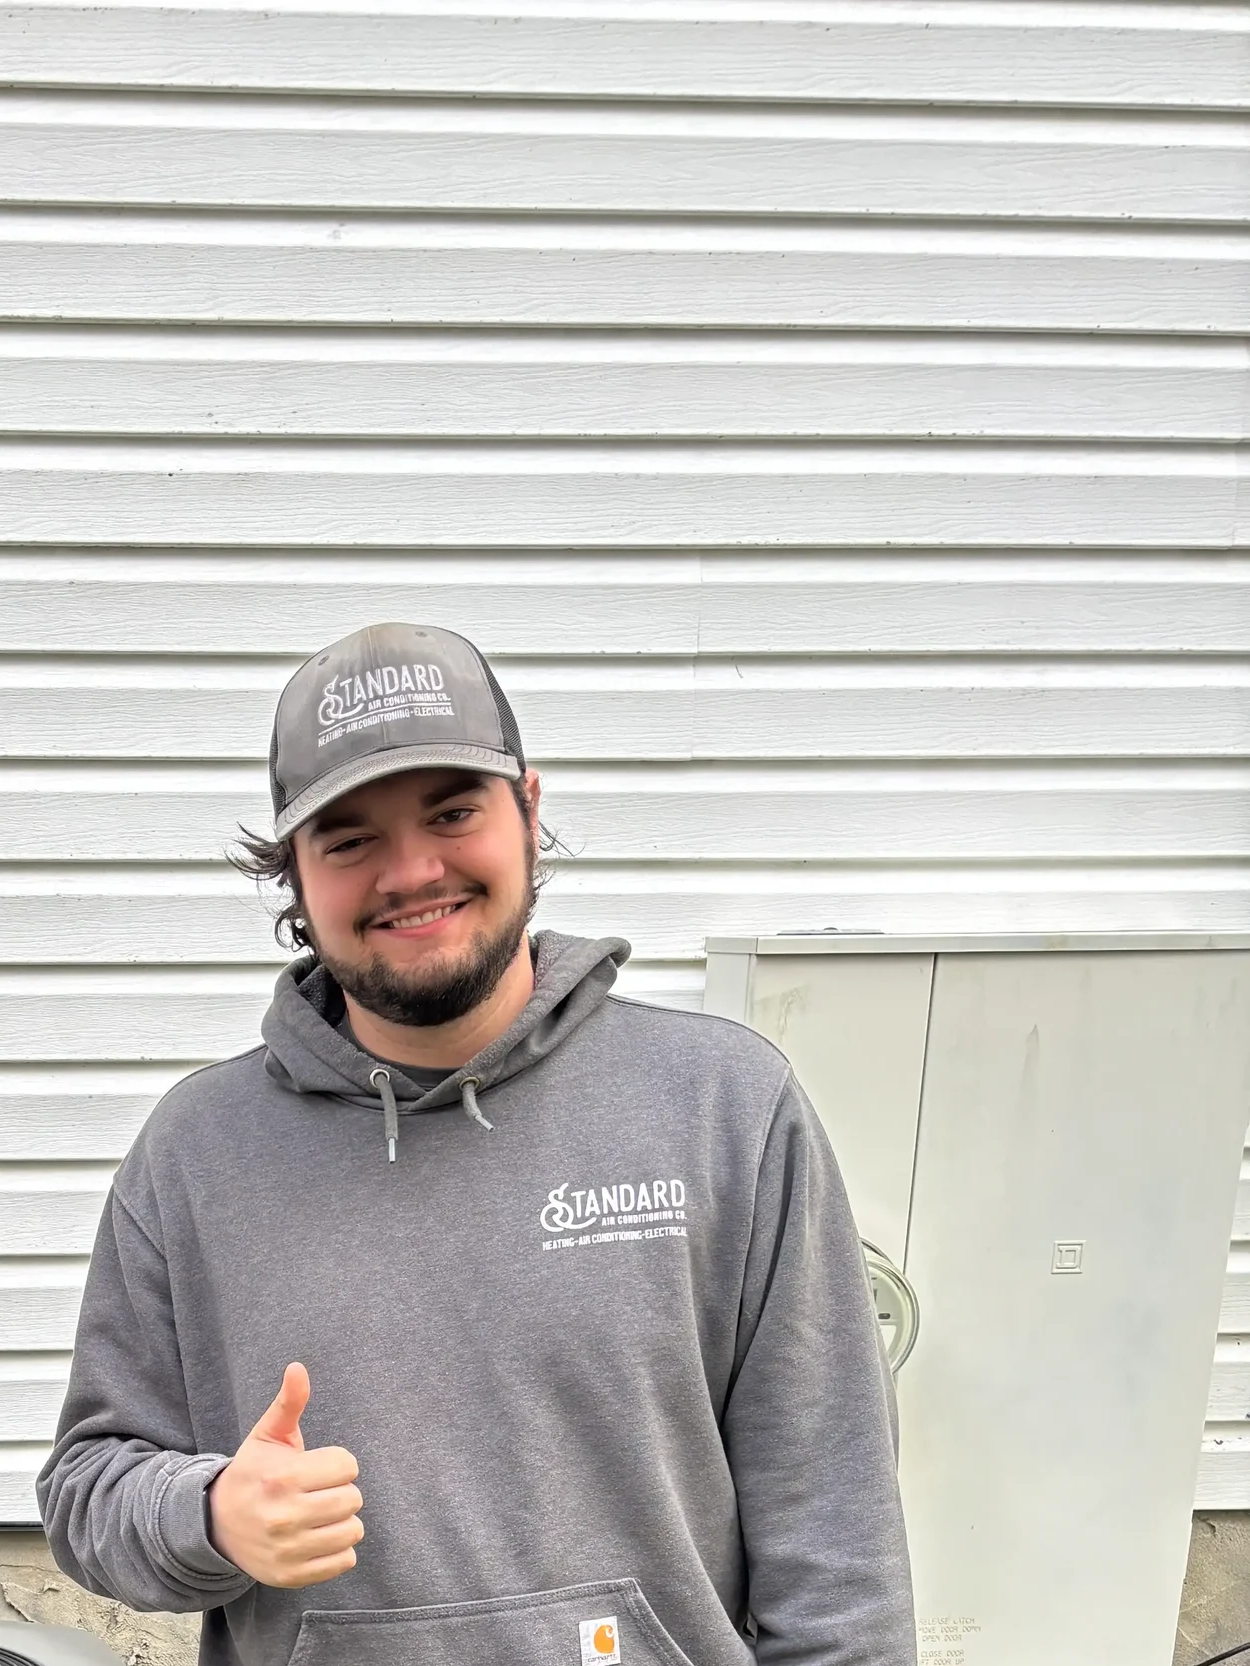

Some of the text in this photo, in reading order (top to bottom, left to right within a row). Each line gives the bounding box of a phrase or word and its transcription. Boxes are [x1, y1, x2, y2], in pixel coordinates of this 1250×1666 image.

[317, 664, 445, 726] STANDARD
[368, 699, 382, 711] AIR
[383, 692, 437, 707] CONDITIONING
[540, 1179, 686, 1233] STANDARD
[601, 1209, 688, 1227] AIR CONDITIONING CO.
[953, 1616, 975, 1625] LATCH
[940, 1625, 958, 1634] DOOR
[922, 1634, 962, 1642] OPEN DOOR
[920, 1649, 965, 1658] CLOSE DOOR
